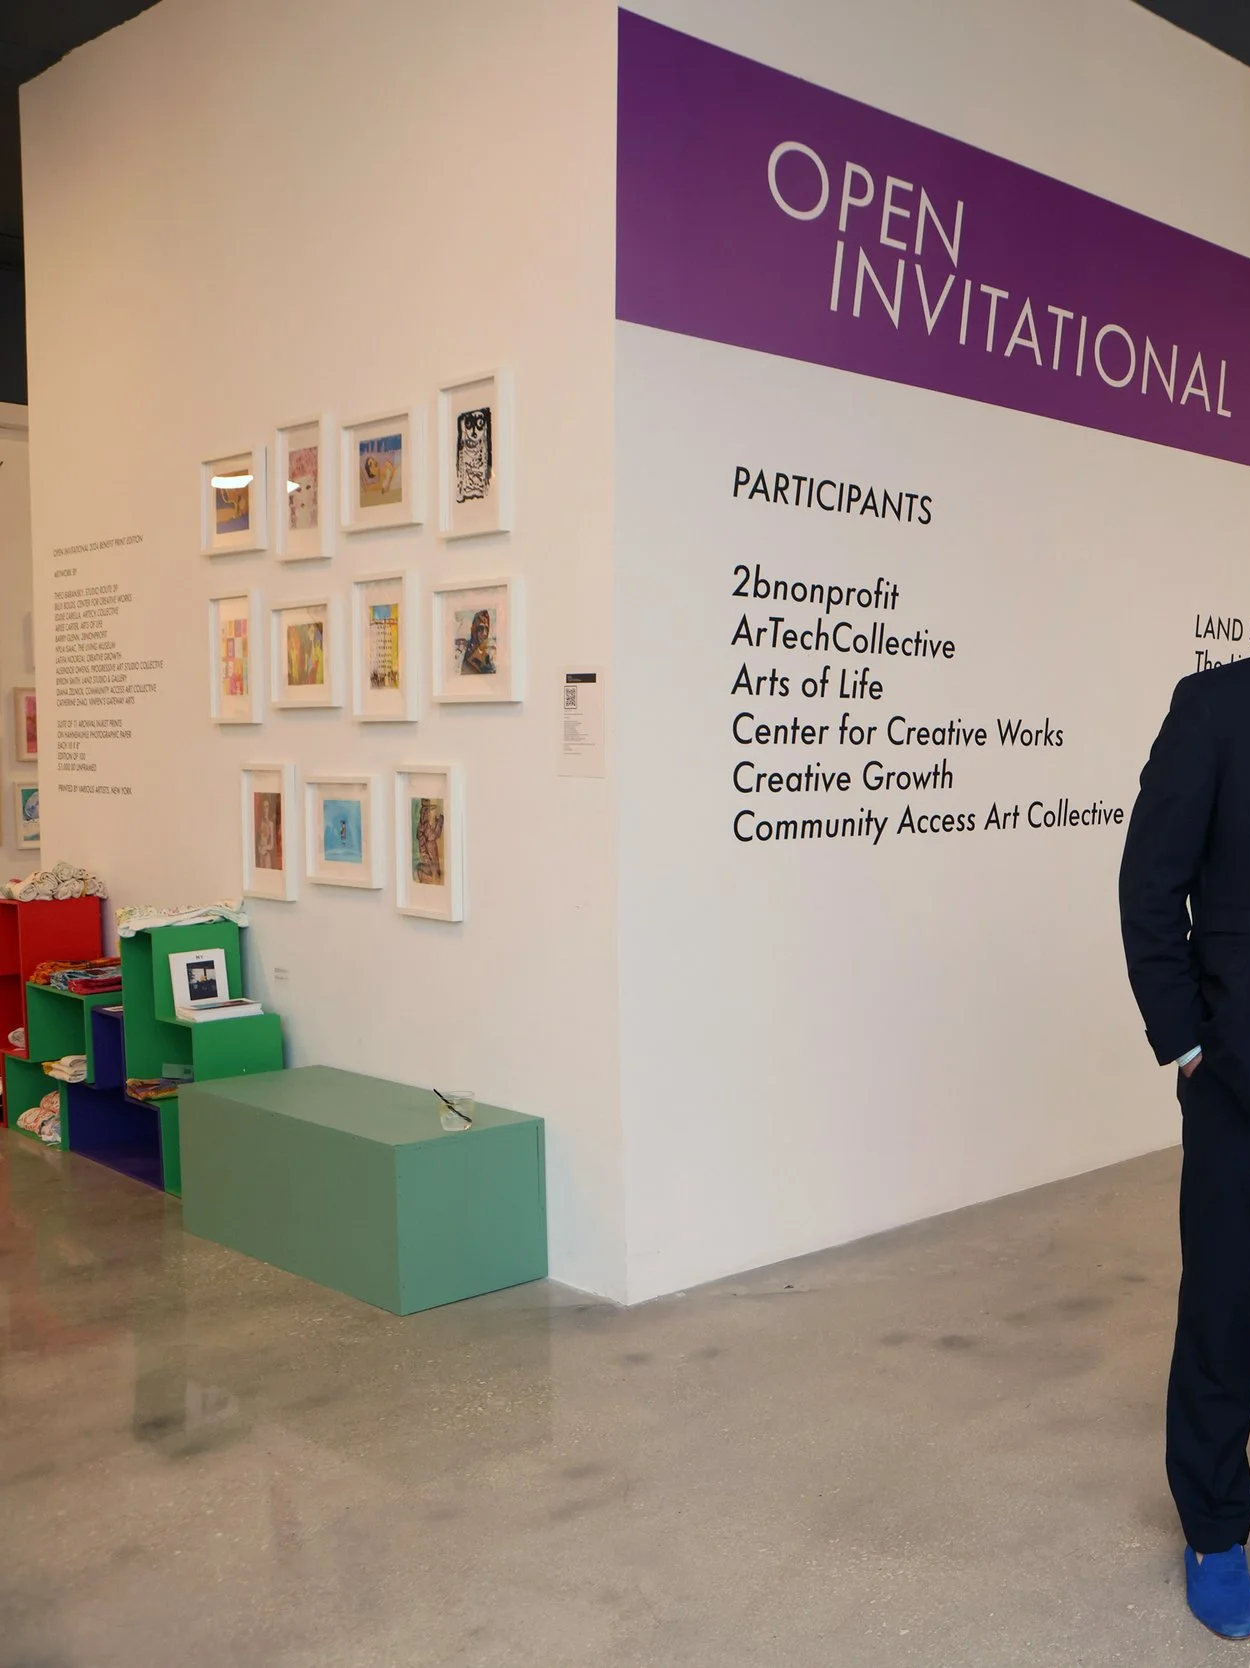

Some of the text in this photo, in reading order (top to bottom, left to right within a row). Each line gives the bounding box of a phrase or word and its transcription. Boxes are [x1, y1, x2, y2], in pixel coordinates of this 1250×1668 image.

[767, 140, 964, 268] OPEN
[829, 239, 1232, 418] INVITATIONAL
[732, 465, 933, 525] PARTICIPANTS
[731, 563, 900, 615] 2bnonprofit
[730, 613, 956, 659] ArTechCollective
[1195, 613, 1244, 642] LAND
[124, 661, 139, 670] STUDIO
[140, 660, 163, 669] COLLECTIVE
[730, 662, 884, 701] Arts of Life
[732, 711, 1064, 747] Center for Creative Works
[732, 757, 954, 794] Creative Growth
[733, 797, 1125, 846] Community Access Art Collective
